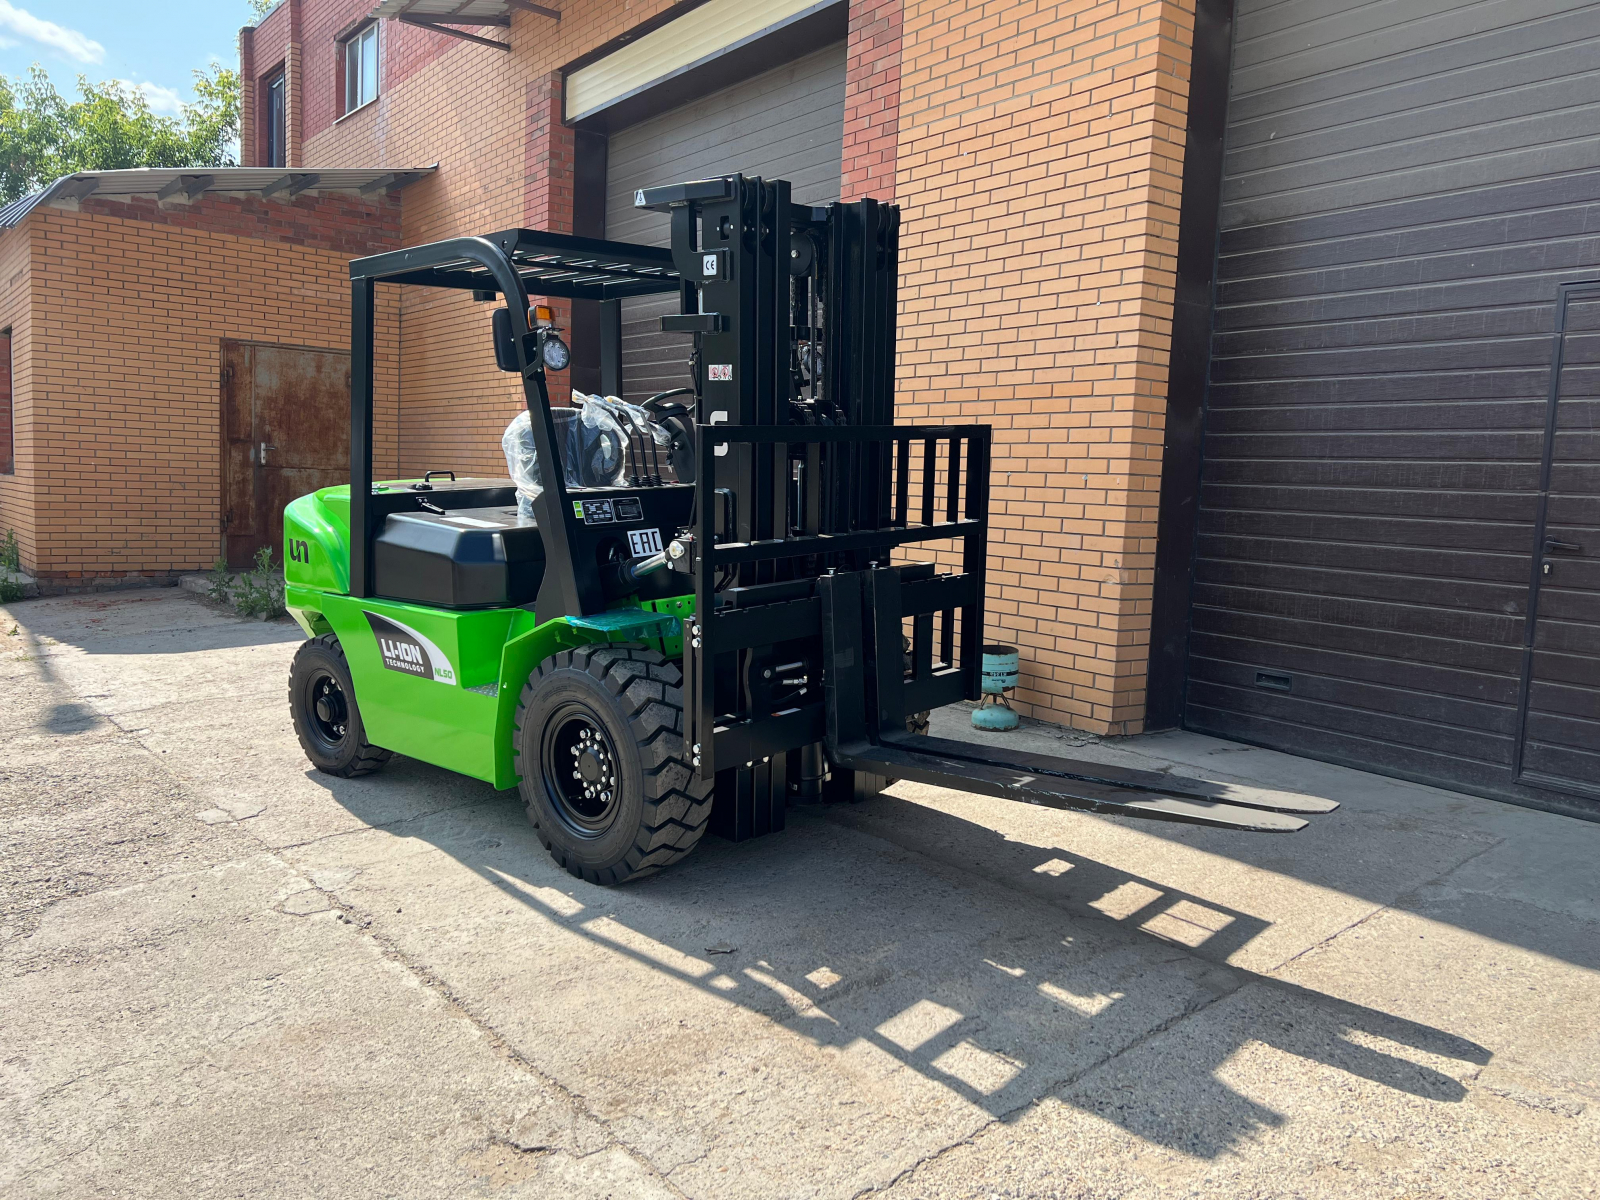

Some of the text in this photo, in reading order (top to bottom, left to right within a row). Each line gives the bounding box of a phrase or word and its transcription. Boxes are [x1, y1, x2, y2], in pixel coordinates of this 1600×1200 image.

[705, 260, 715, 270] CE
[630, 531, 661, 554] EAC
[381, 638, 423, 664] LI-ION
[386, 658, 425, 673] TECHNOLOGY
